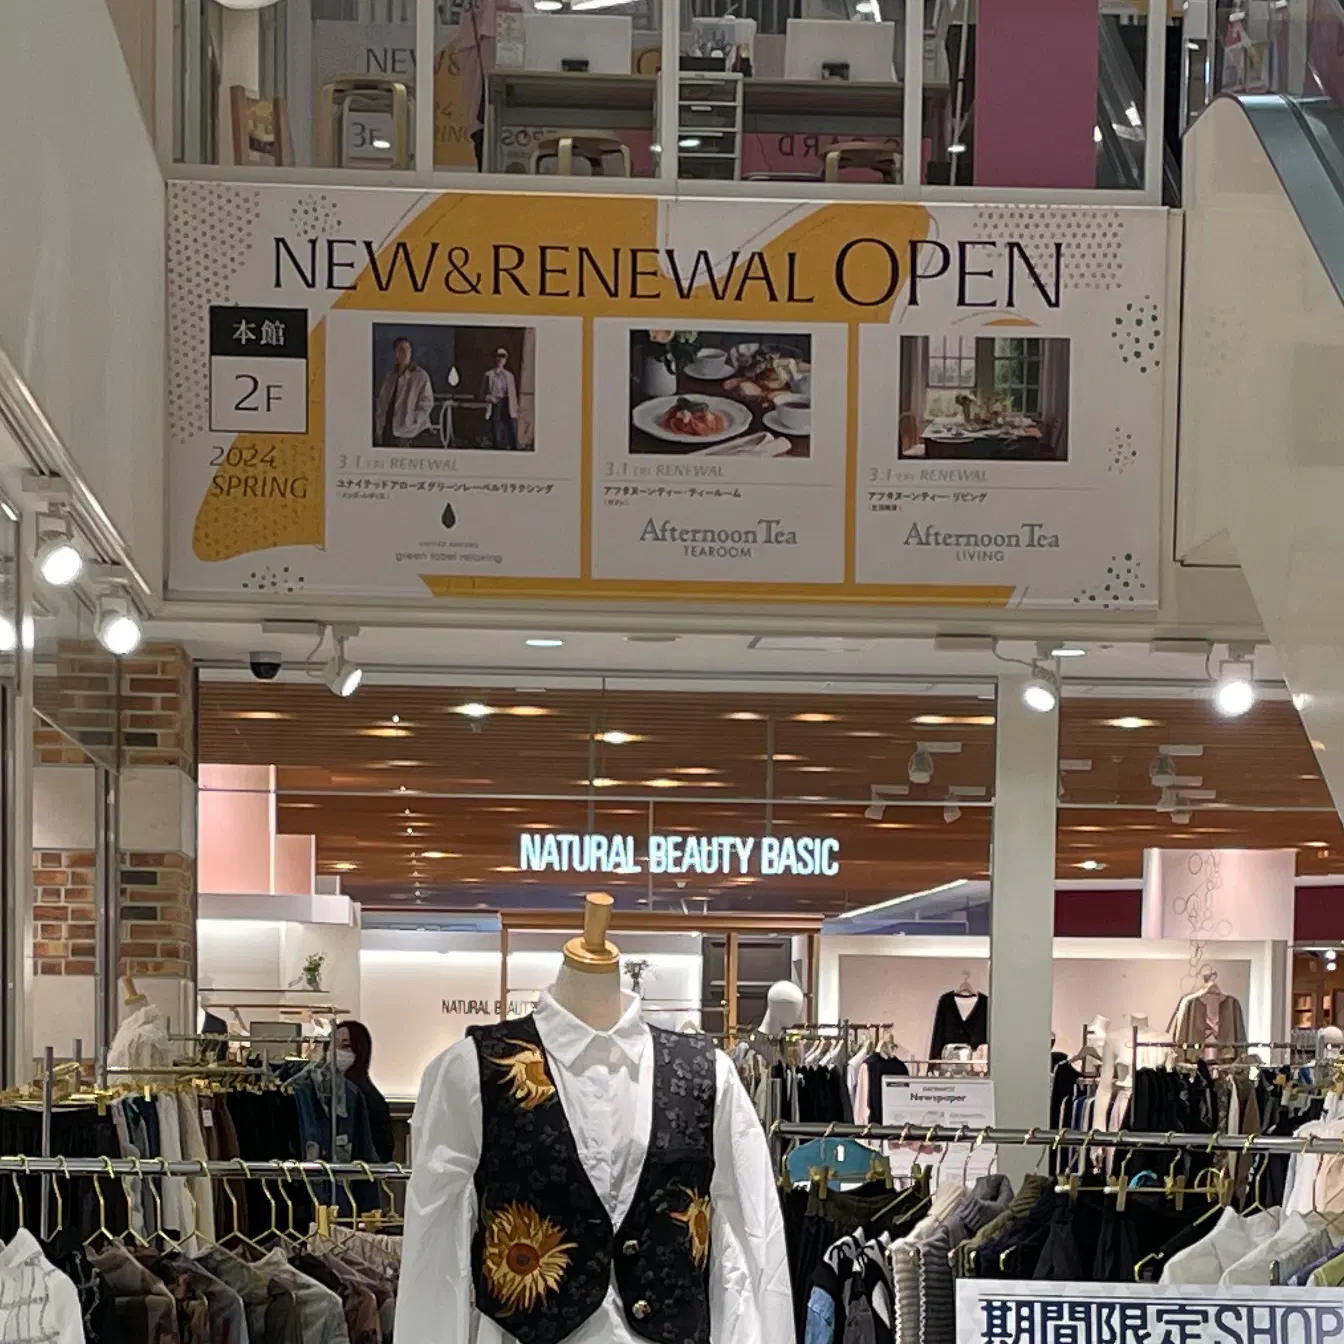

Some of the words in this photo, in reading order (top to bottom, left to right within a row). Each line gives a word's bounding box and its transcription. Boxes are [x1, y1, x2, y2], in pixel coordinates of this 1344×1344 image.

[272, 236, 815, 304] NEW&RENEWAL
[835, 237, 1064, 308] OPEN
[232, 319, 286, 347] 本館
[233, 374, 284, 412] 2F
[209, 446, 277, 468] 2024
[390, 457, 458, 471] RENEWAL
[656, 464, 724, 477] RENEWAL
[920, 470, 989, 482] RENEWAL
[210, 474, 309, 499] SPRING
[640, 517, 758, 544] Afternoon
[757, 518, 798, 545] Tea
[903, 521, 1020, 547] Afternoon
[1020, 523, 1060, 548] Tea
[684, 545, 752, 558] TEAROOM
[957, 550, 1004, 562] LIVING
[520, 833, 642, 873] NATURAL
[648, 836, 754, 874] BEAUTY
[761, 836, 839, 875] BASIC
[441, 999, 490, 1015] NATURAL
